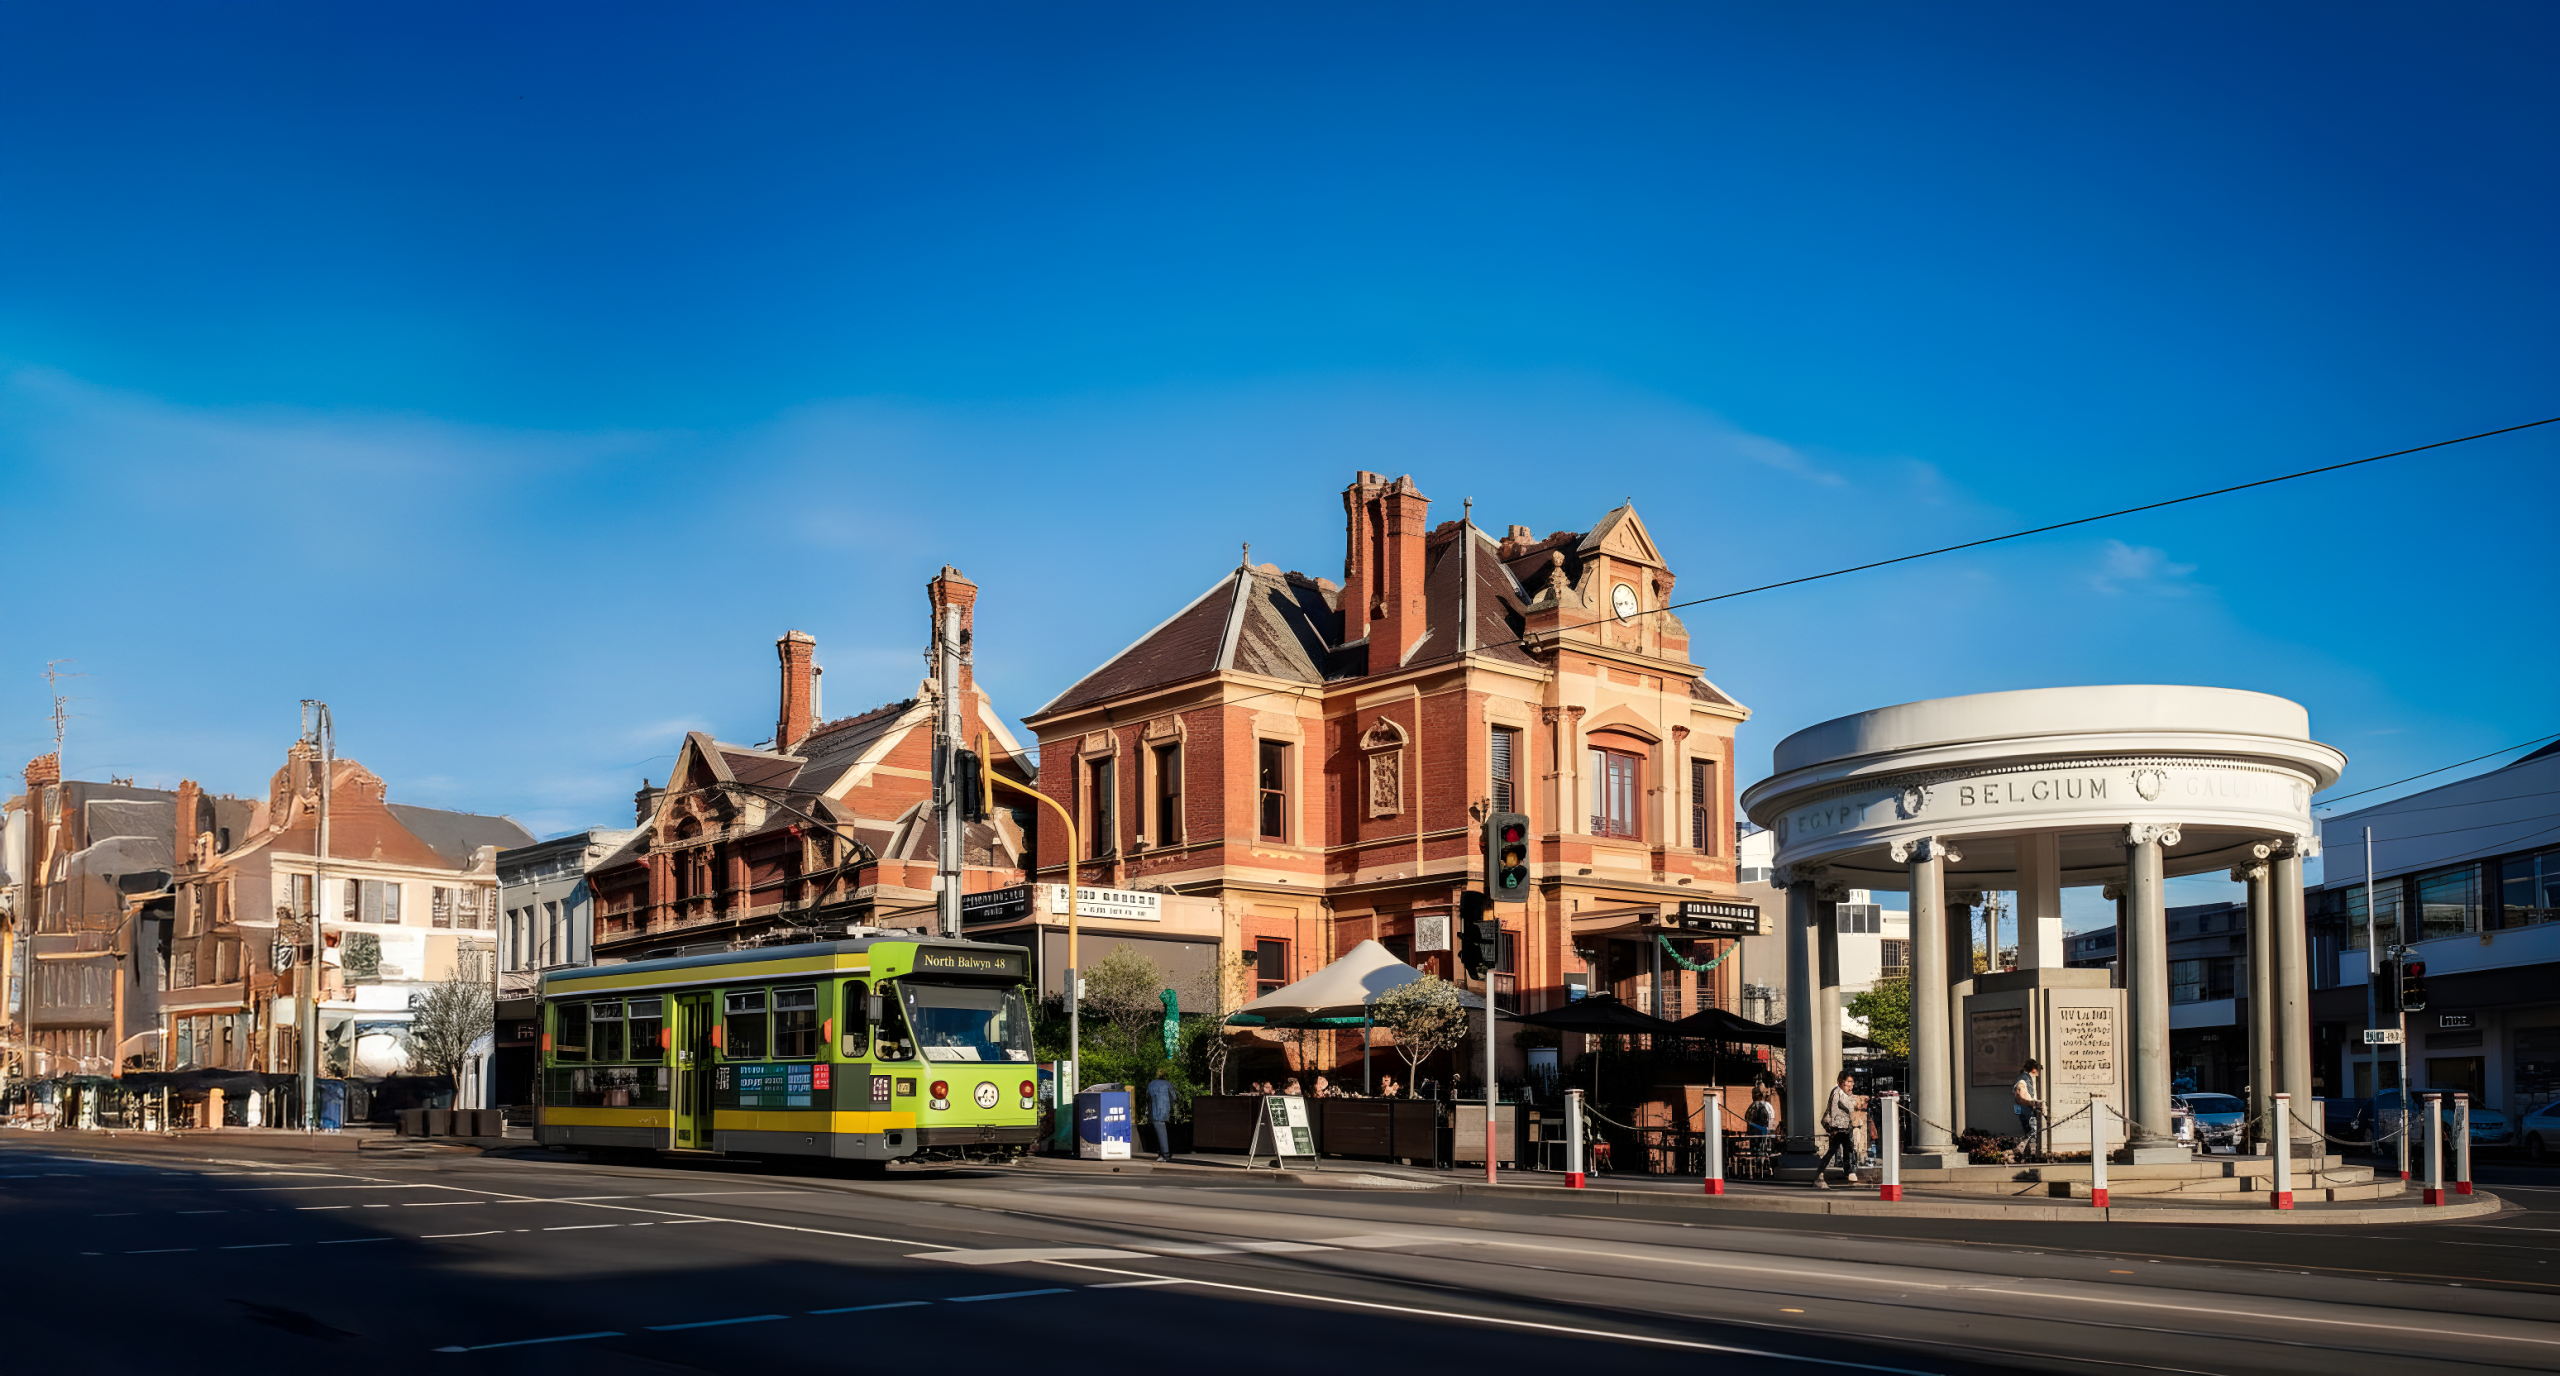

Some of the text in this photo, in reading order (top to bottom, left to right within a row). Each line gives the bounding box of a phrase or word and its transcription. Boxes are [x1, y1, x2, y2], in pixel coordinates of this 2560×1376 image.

[1960, 778, 2107, 807] BELGIUM
[1798, 803, 1868, 834] EGYPT
[924, 954, 1006, 971] North Balwyn 48
